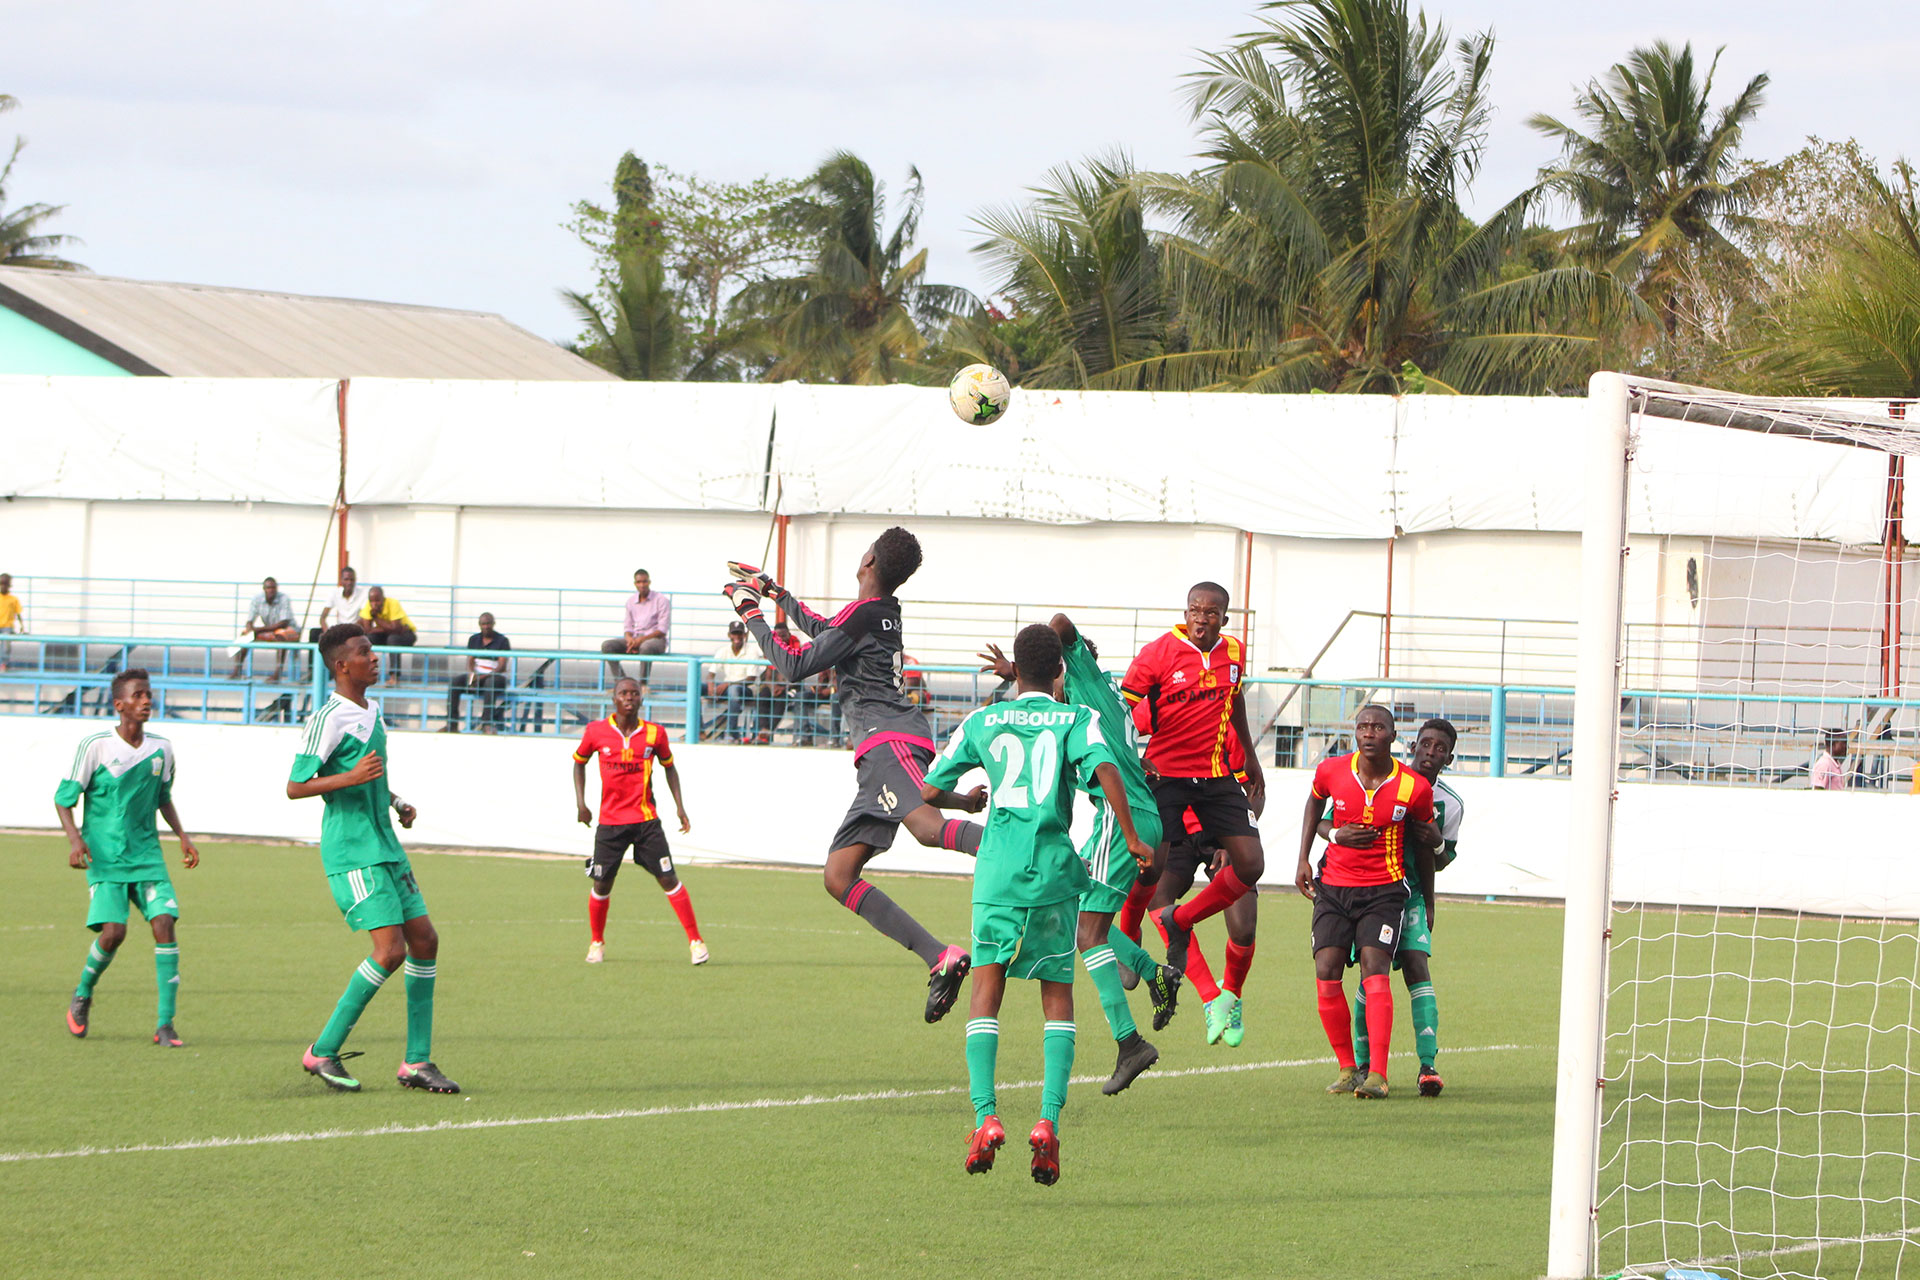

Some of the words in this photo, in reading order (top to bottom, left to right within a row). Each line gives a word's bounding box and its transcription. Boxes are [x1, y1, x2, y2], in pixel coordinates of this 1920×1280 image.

[1199, 669, 1217, 688] 15
[1167, 689, 1225, 704] UGANDA
[984, 710, 1077, 727] DJIBOUTI
[621, 748, 634, 762] 10
[602, 761, 642, 772] GANDA
[988, 729, 1058, 809] 20
[877, 783, 898, 815] 16
[1361, 805, 1375, 824] 5
